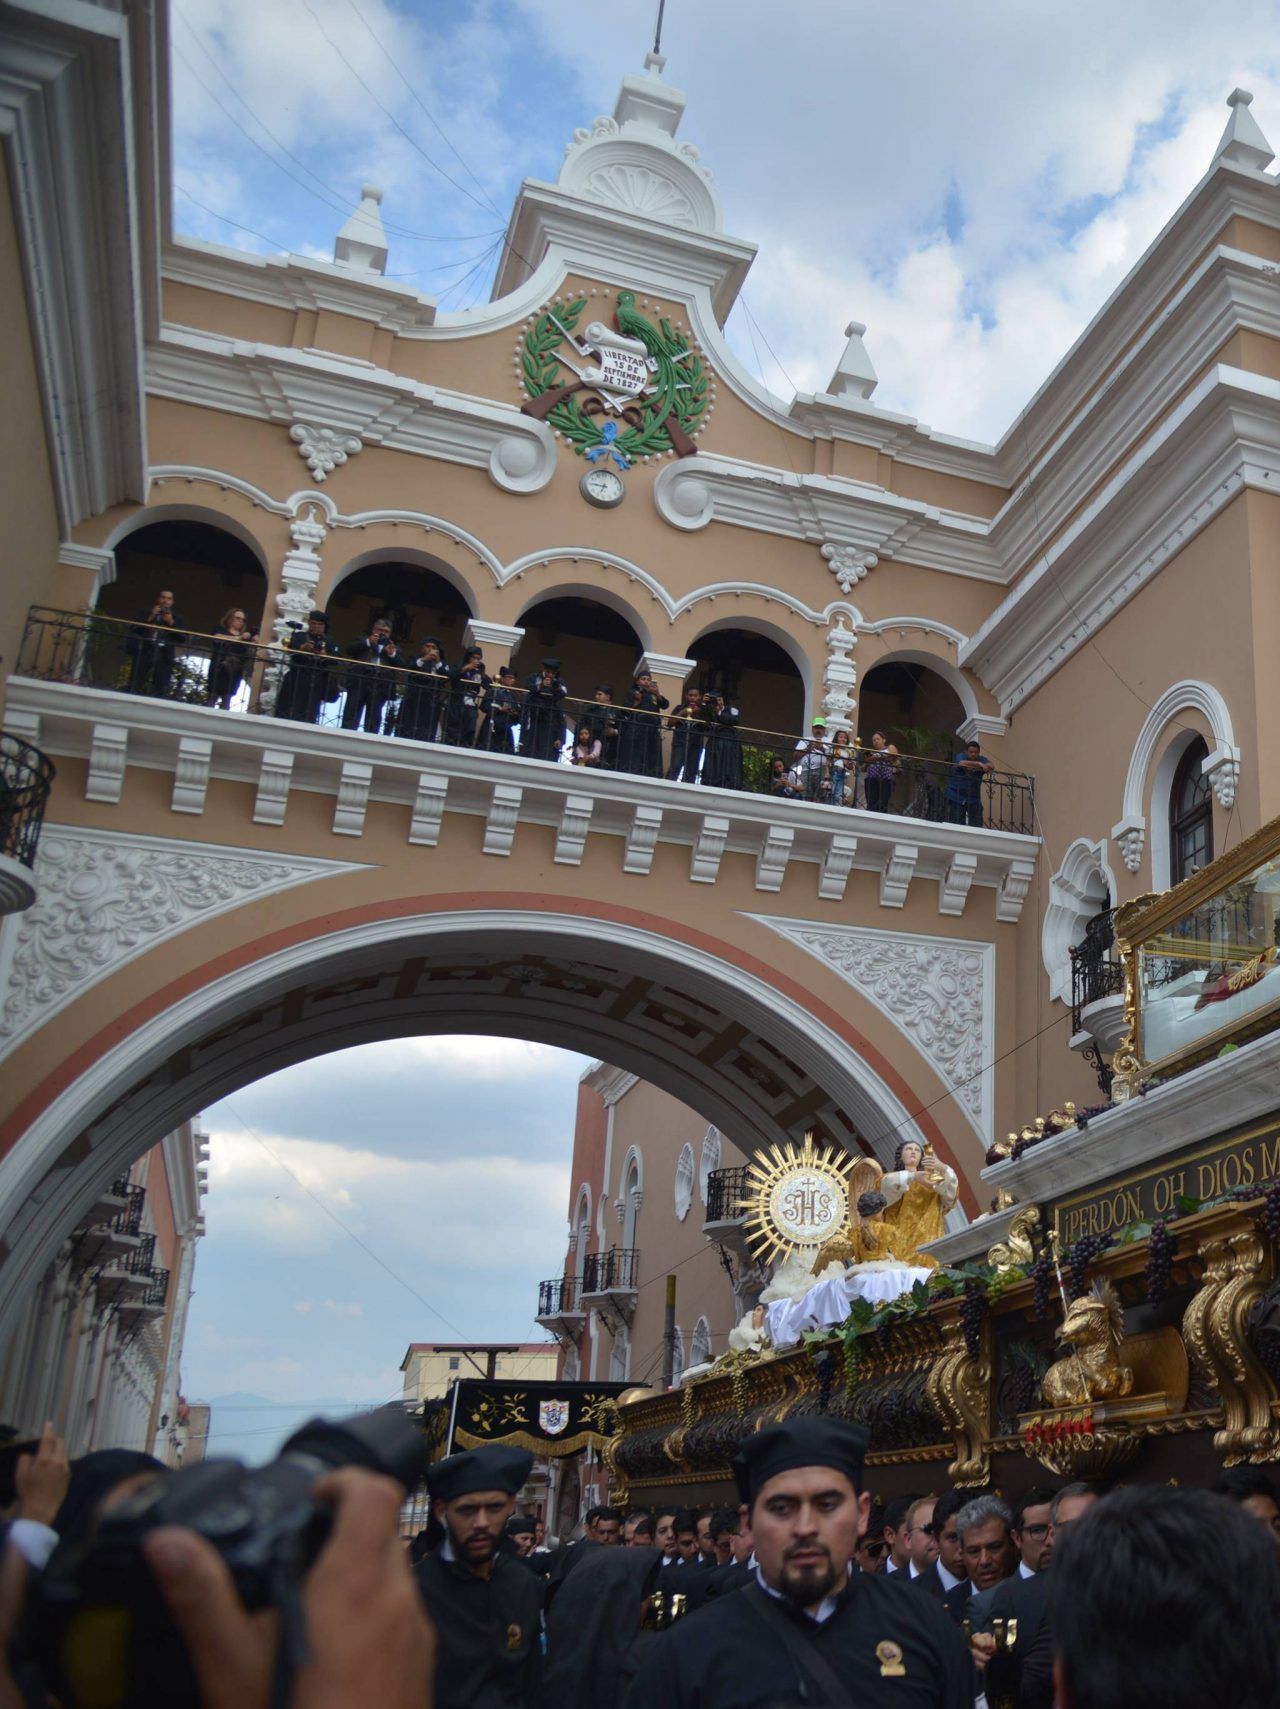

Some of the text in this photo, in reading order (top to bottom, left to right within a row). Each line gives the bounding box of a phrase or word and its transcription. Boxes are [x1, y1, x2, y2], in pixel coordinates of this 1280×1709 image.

[604, 351, 644, 367] LIBERTAD
[603, 367, 646, 384] SEPTIEMBRE
[614, 361, 639, 374] 15 DE
[603, 375, 614, 384] DE
[1153, 1171, 1186, 1213] OH
[1197, 1147, 1255, 1201] DIOS
